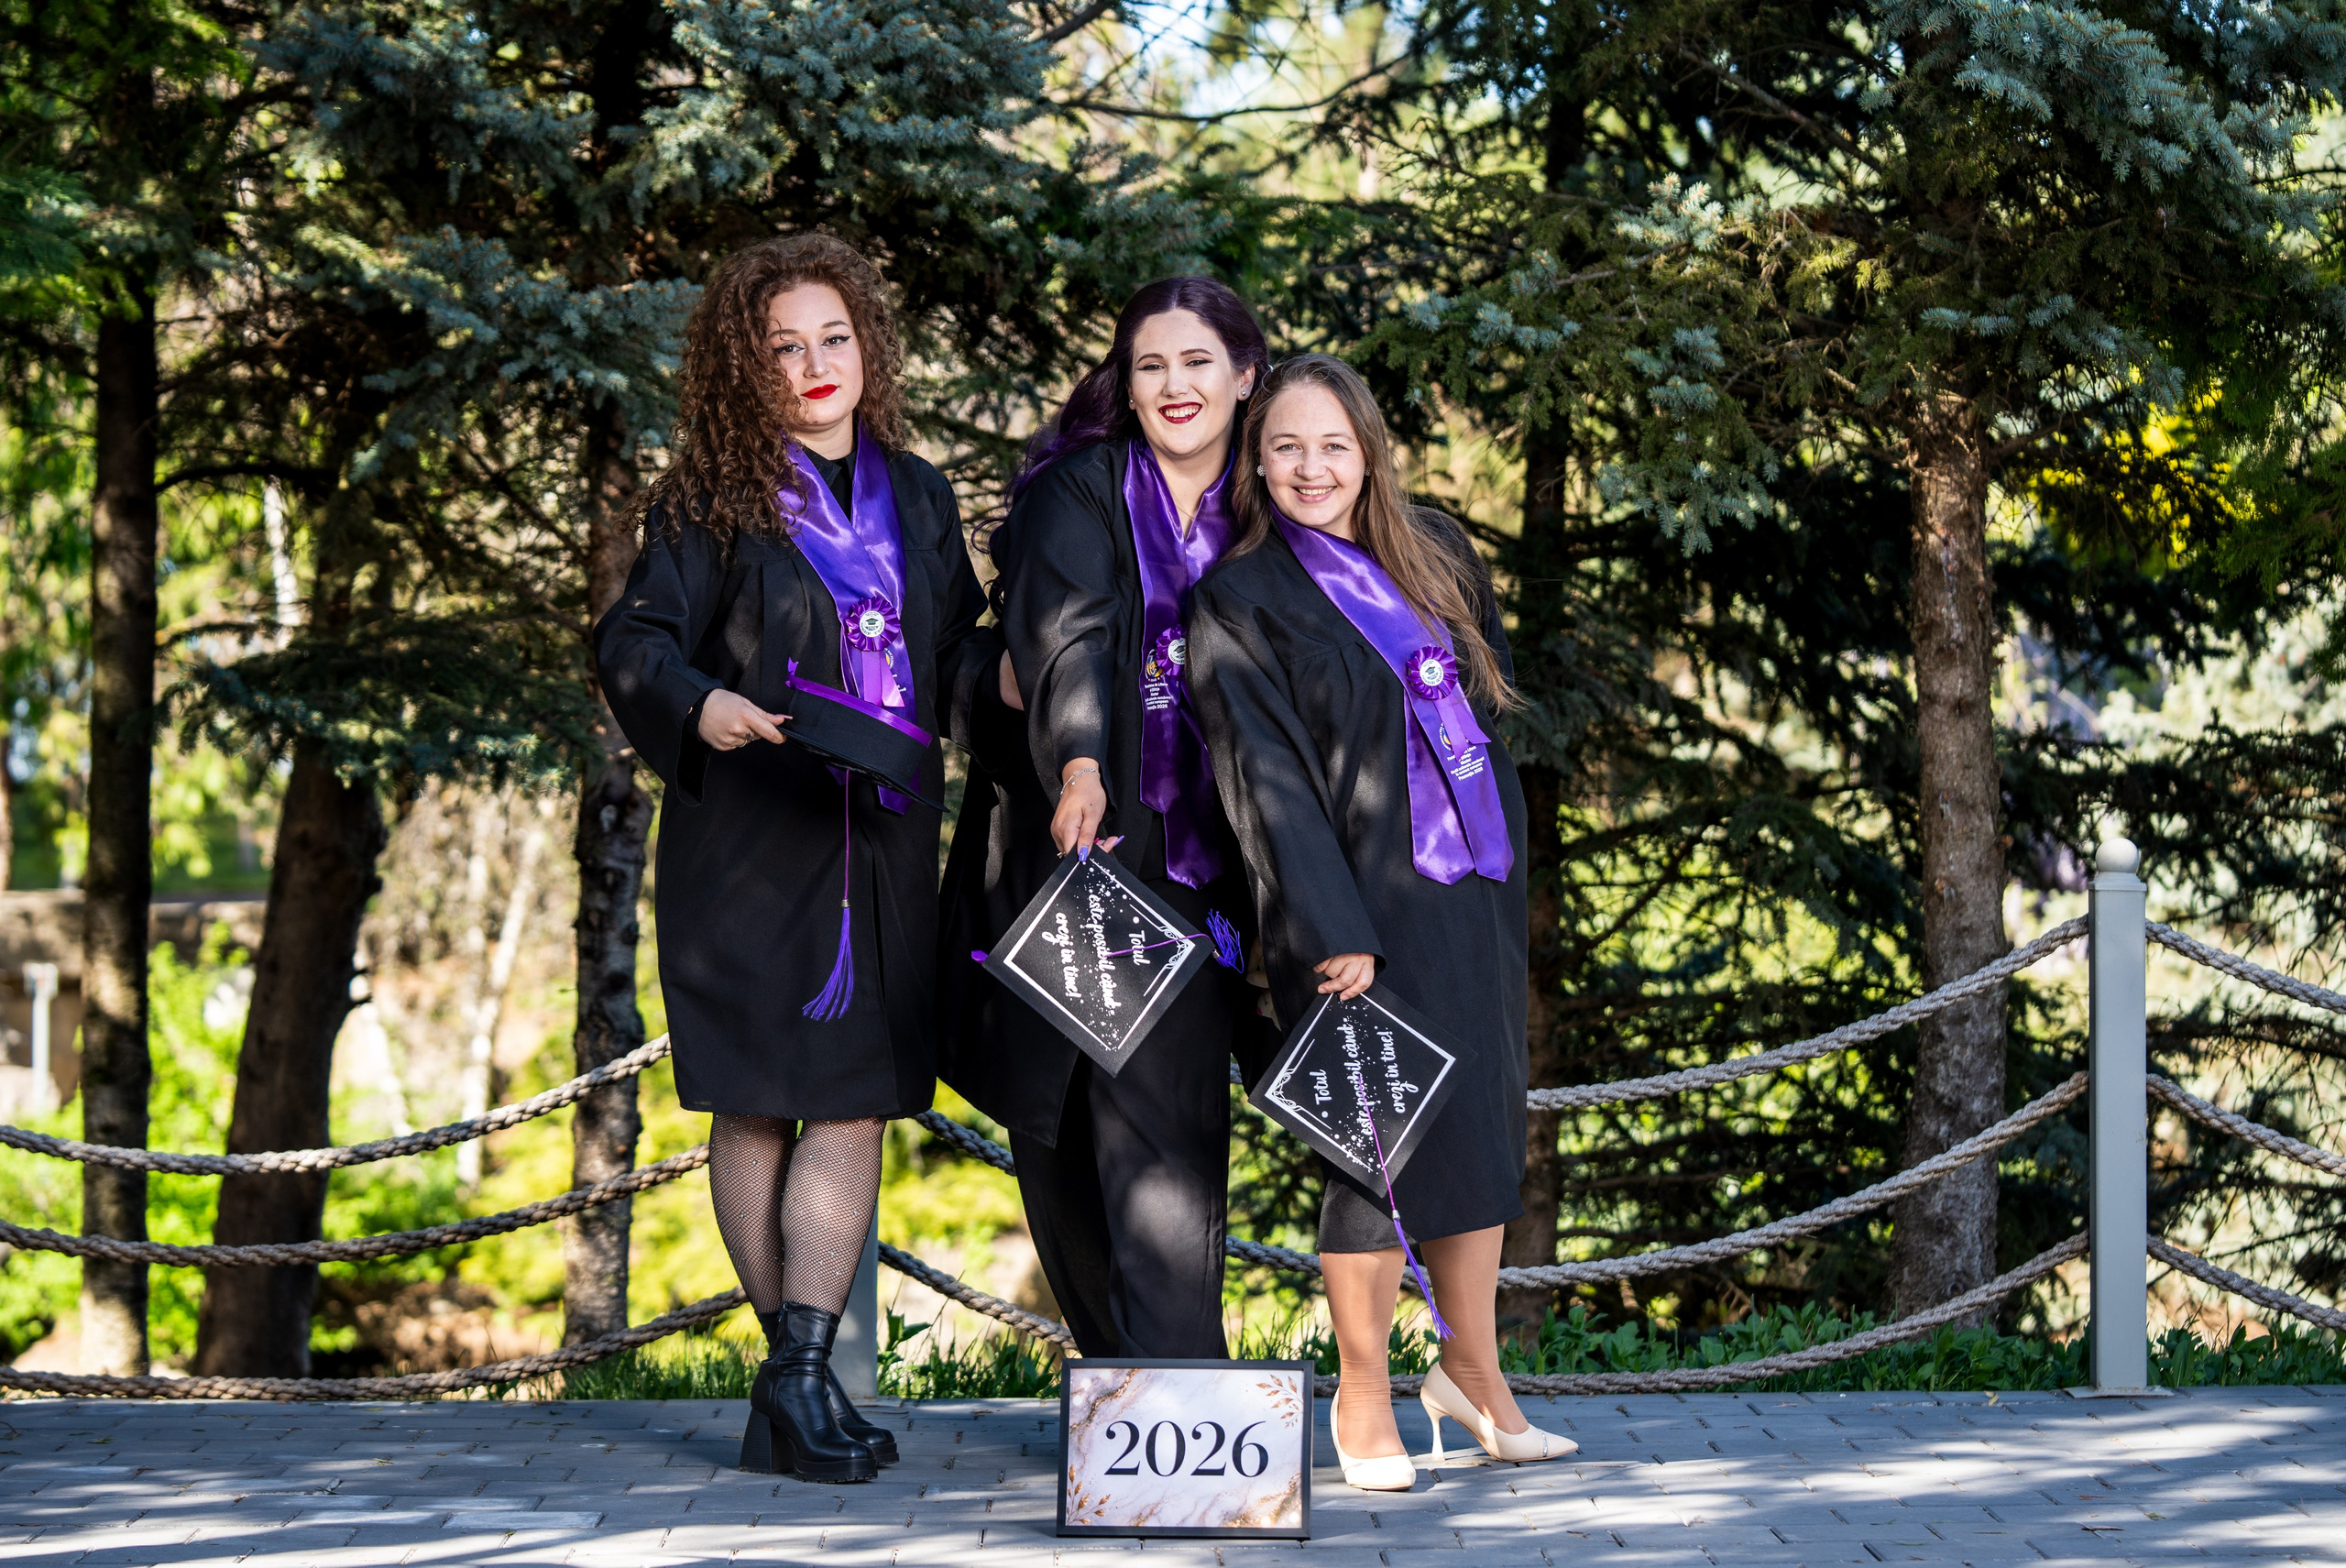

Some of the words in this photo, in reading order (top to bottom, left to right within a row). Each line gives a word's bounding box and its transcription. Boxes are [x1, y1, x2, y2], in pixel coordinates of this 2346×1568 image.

[1089, 894, 1105, 923] este
[1043, 913, 1074, 948] crezi
[1063, 965, 1082, 998] tine!
[1085, 923, 1116, 971] posibil
[1128, 929, 1151, 966] Totul
[1100, 972, 1122, 1009] când
[1336, 1024, 1359, 1058] când
[1376, 1031, 1397, 1062] tine!
[1309, 1069, 1332, 1105] Totul
[1343, 1059, 1376, 1106] posibil
[1385, 1062, 1400, 1079] în
[1387, 1080, 1420, 1113] crezi
[1356, 1106, 1374, 1136] este
[1103, 1420, 1269, 1477] 2026
